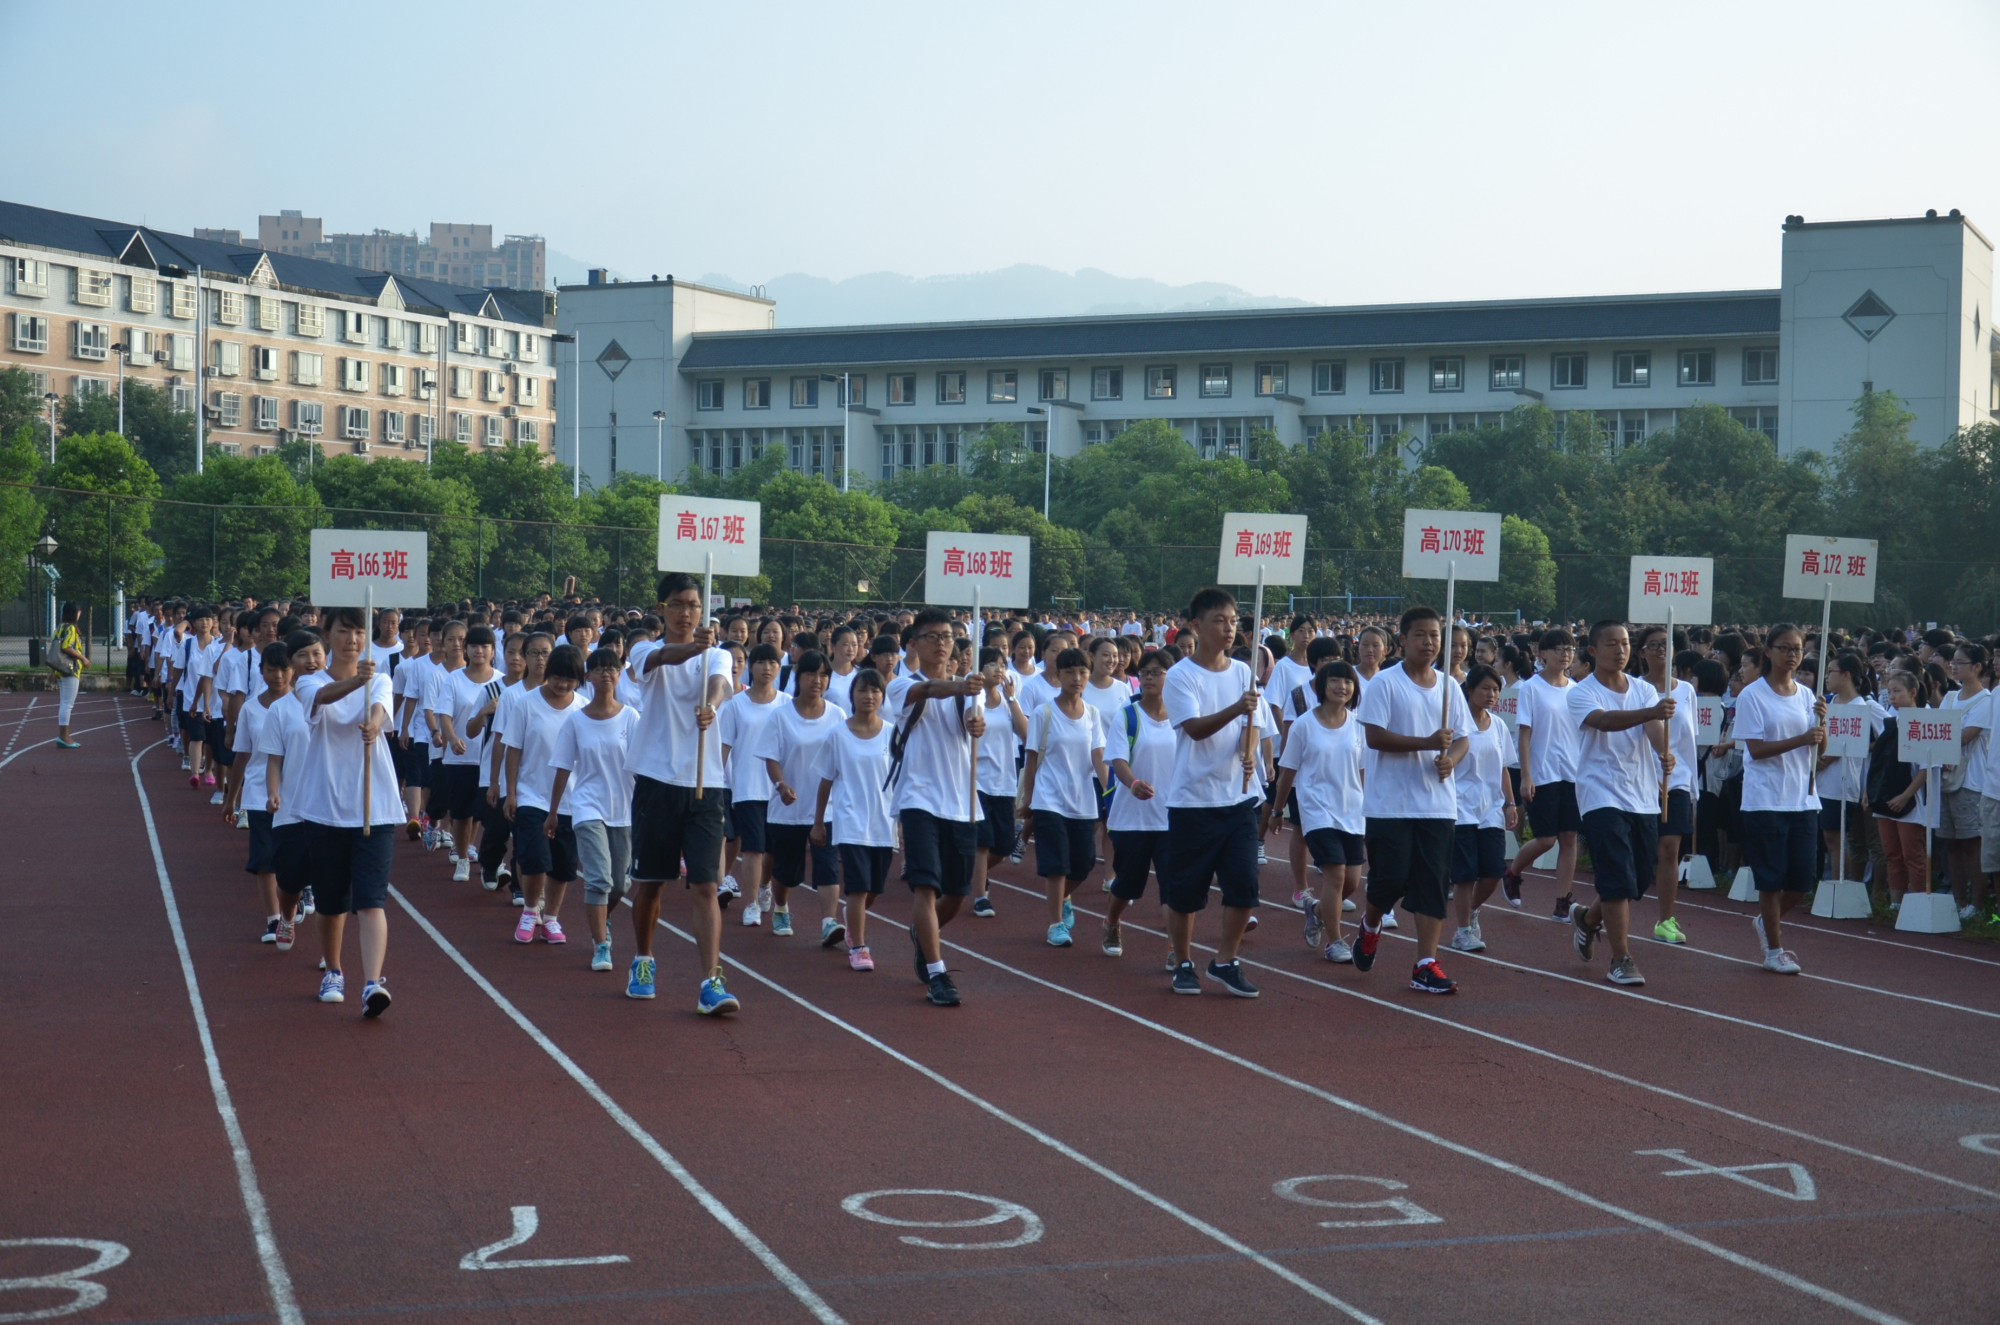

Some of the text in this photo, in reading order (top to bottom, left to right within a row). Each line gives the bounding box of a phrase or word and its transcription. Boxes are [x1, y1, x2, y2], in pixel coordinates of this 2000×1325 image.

[677, 509, 746, 544] 高167班
[1420, 524, 1486, 556] 高170班
[1234, 529, 1293, 558] 高169班
[330, 548, 409, 581] 高166班
[943, 546, 1013, 579] 高168班
[1801, 549, 1866, 577] 高172班
[1643, 568, 1700, 597] 高171班
[1828, 716, 1862, 737] 高150班
[1908, 719, 1952, 741] 高151班
[1635, 1148, 1817, 1201] 4
[1272, 1174, 1443, 1228] 5
[459, 1205, 631, 1271] 7
